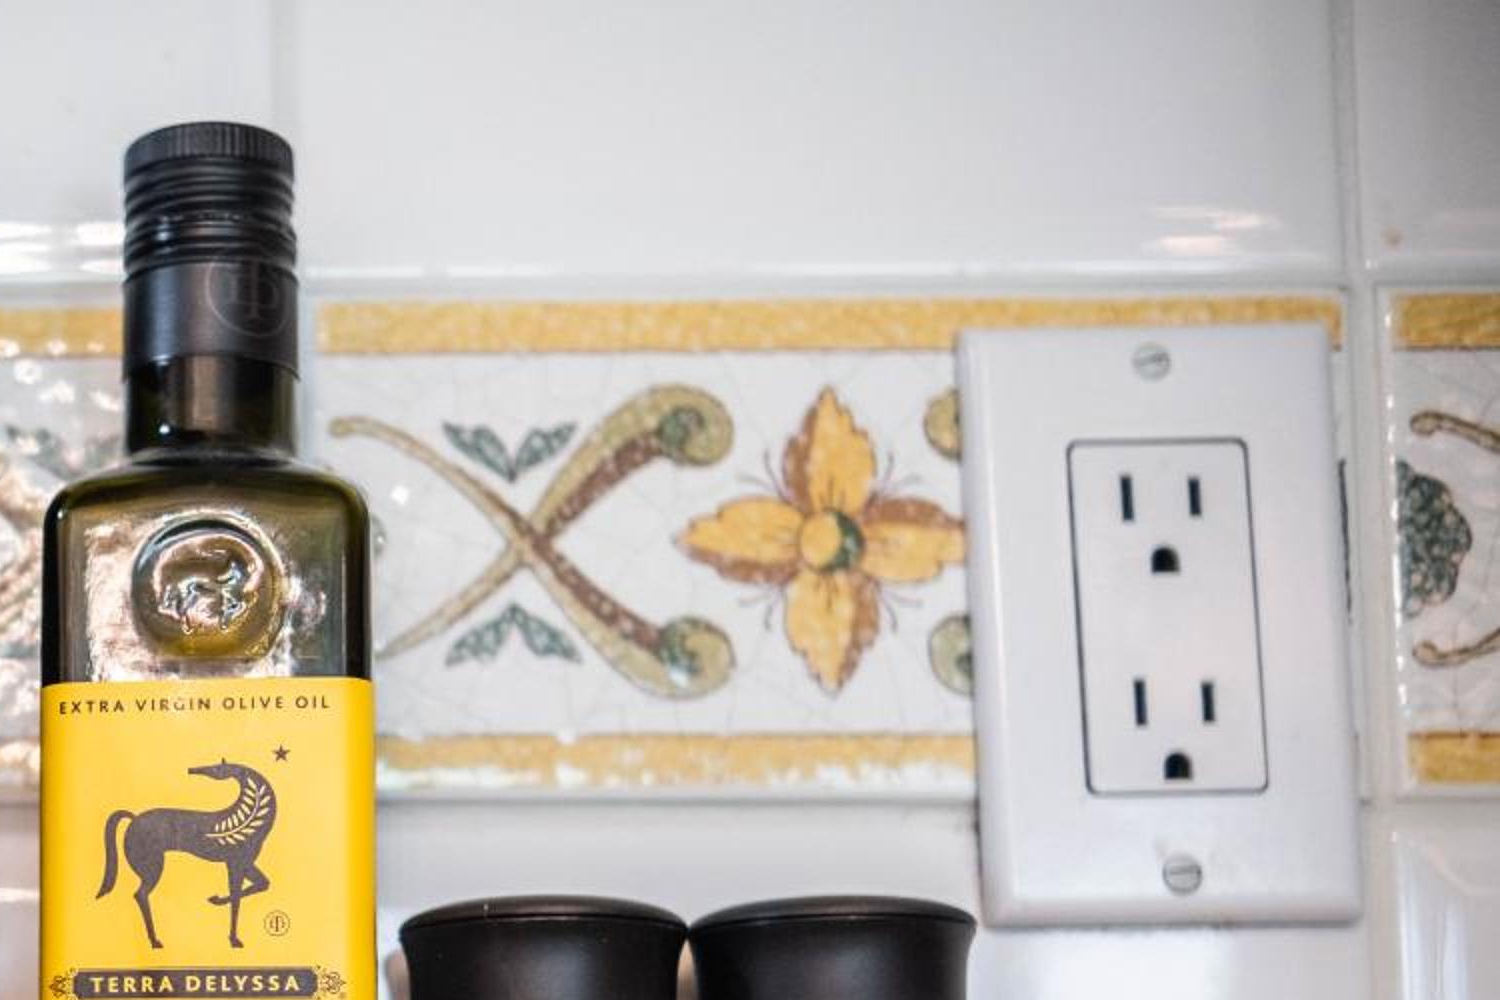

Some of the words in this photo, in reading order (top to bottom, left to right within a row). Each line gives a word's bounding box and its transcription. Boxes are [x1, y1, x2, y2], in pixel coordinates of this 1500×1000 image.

[59, 700, 125, 715] EXTRA
[136, 697, 212, 713] VIRGIN
[222, 696, 284, 711] OLIVE
[295, 695, 331, 710] OIL
[90, 976, 174, 993] TERRA
[185, 974, 301, 992] DELYSSA
